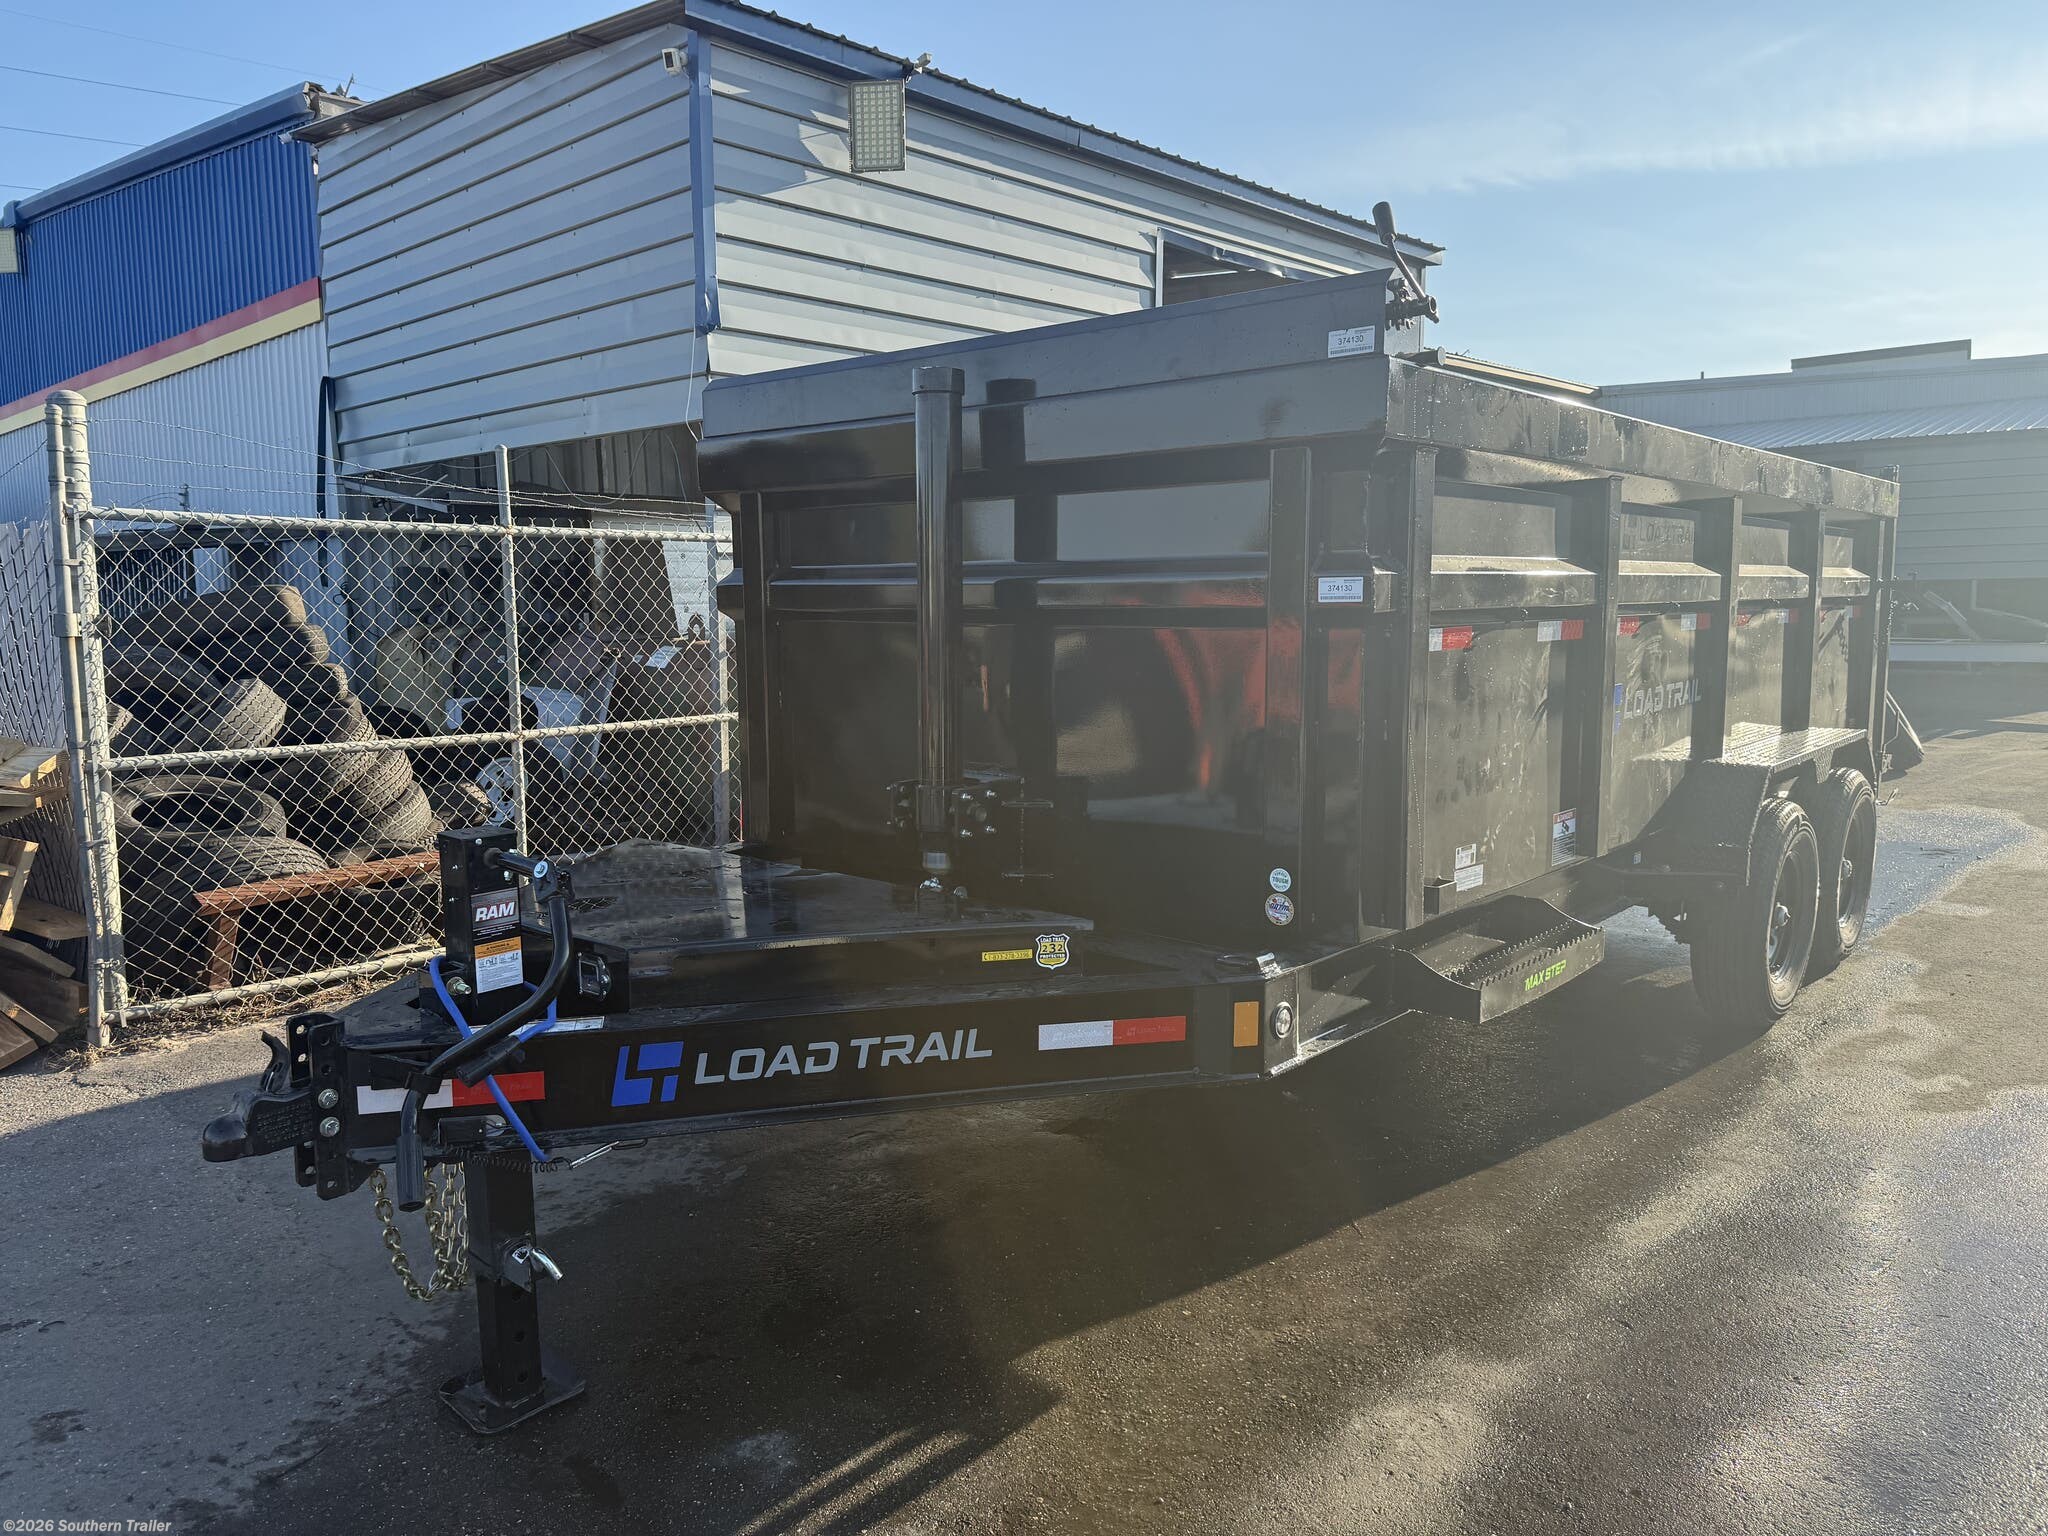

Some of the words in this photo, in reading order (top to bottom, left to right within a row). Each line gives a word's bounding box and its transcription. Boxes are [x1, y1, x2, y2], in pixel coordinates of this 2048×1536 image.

[1337, 335, 1364, 345] 374130
[1327, 584, 1353, 592] 374130
[1624, 682, 1664, 719] LOAD
[1666, 678, 1702, 709] TRAIL
[475, 901, 515, 921] RAM
[1525, 970, 1545, 991] MAX
[1545, 960, 1567, 981] STEP
[694, 1040, 840, 1085] LOAD
[849, 1028, 993, 1069] TRAIL
